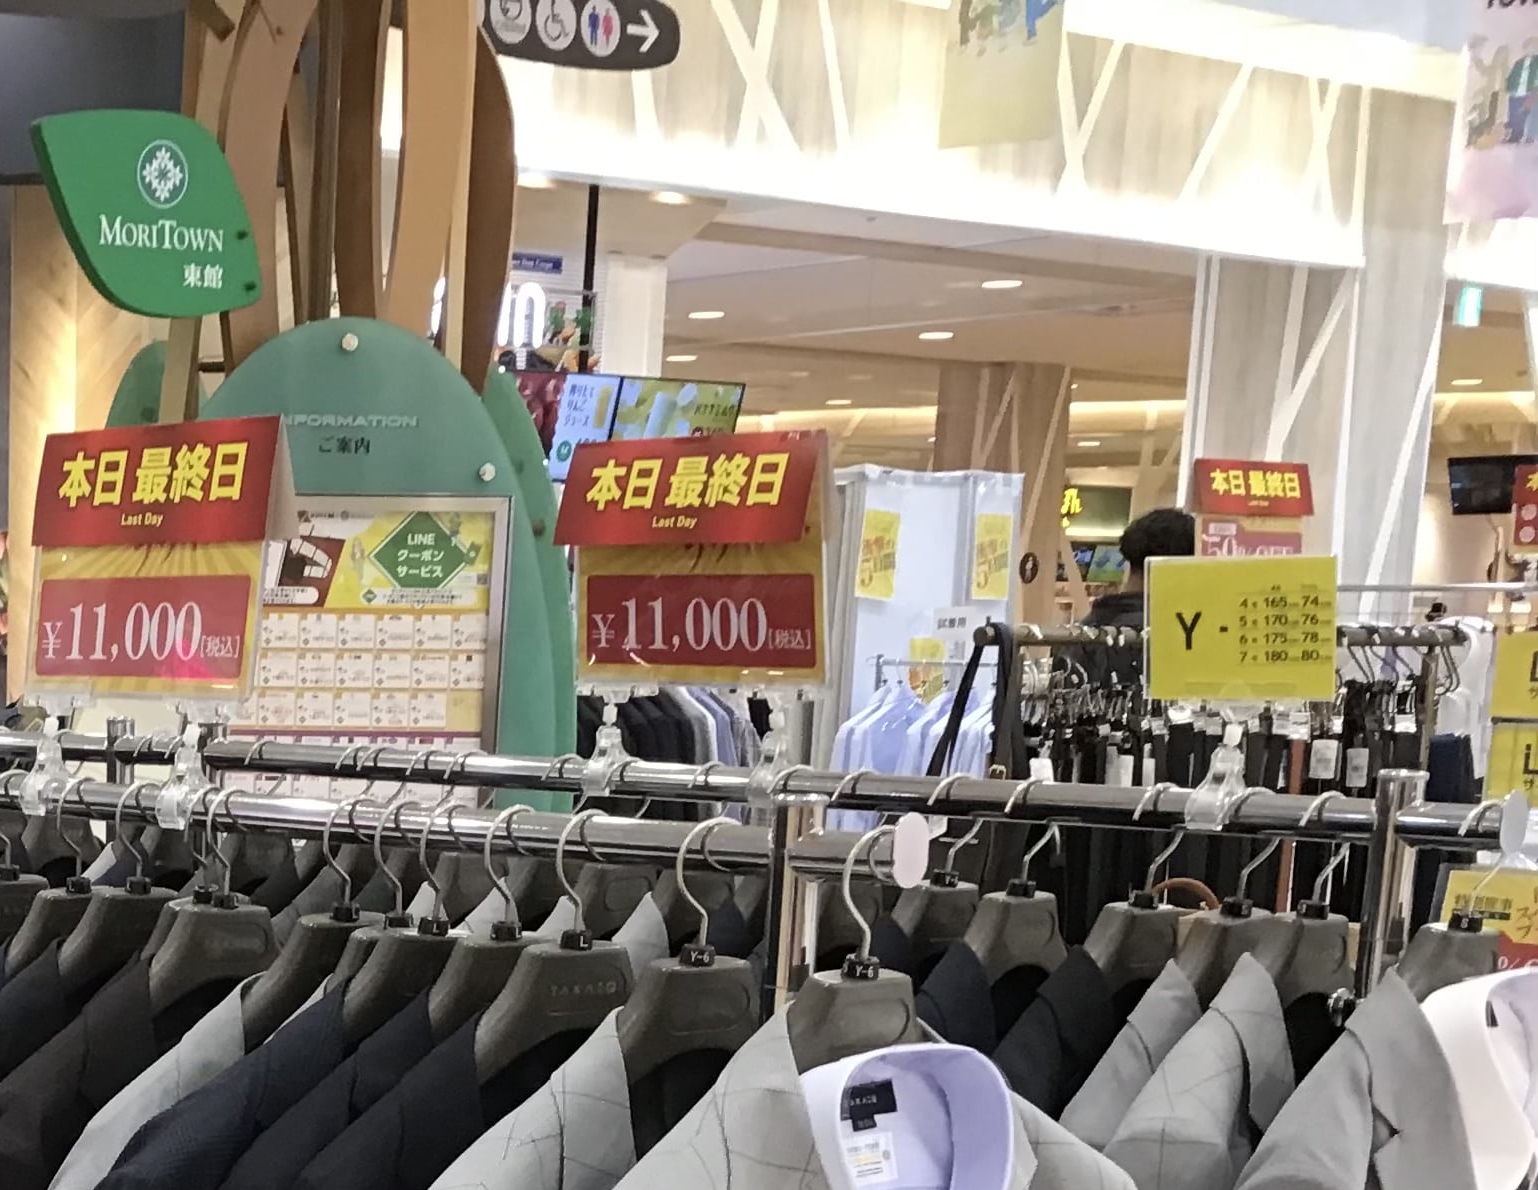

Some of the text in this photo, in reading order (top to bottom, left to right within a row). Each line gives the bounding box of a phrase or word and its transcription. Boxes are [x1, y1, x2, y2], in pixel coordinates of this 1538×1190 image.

[183, 263, 223, 289] 東館
[284, 413, 418, 428] NFORMATION
[319, 436, 371, 454] ご案内
[120, 512, 164, 528] Last Day
[651, 515, 698, 530] Last Day
[407, 532, 437, 547] LINE
[396, 565, 444, 579] サービス
[855, 965, 874, 979] Y-6
